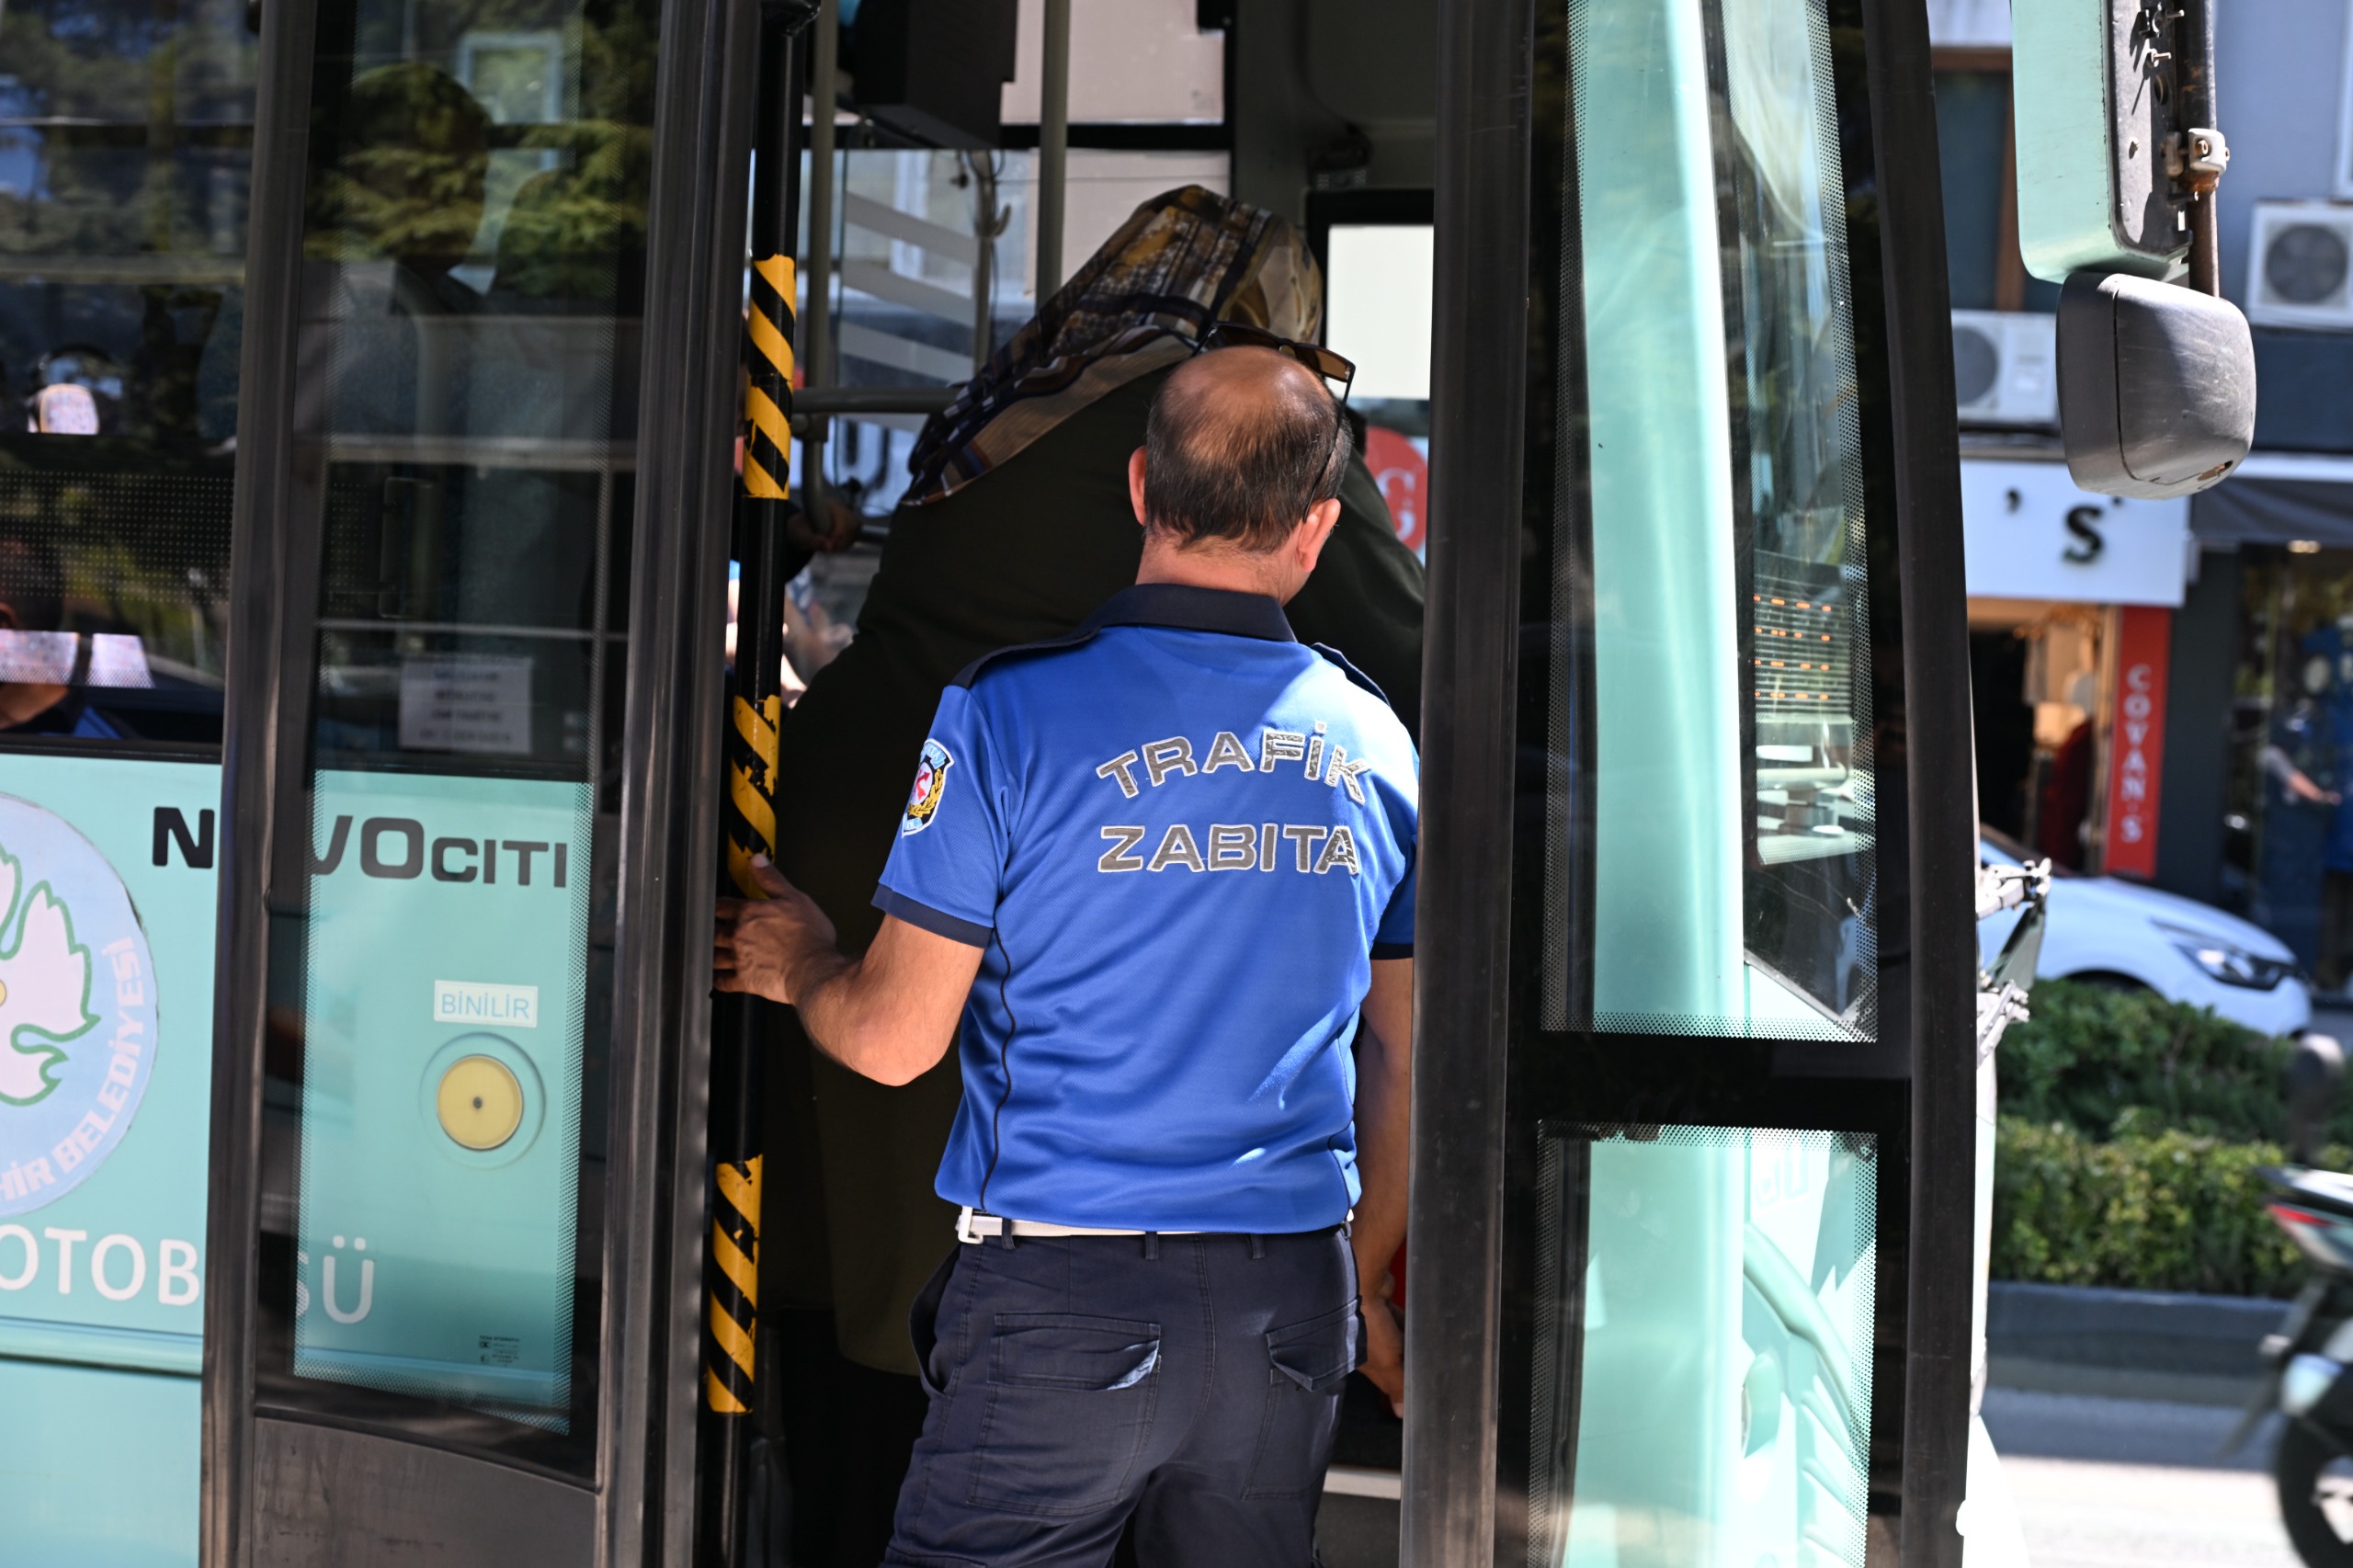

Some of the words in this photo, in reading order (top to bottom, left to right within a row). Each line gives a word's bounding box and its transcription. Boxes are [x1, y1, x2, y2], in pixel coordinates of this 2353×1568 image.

[1096, 721, 1371, 806] TRAFİK
[1097, 824, 1359, 875] ZABITA
[441, 991, 530, 1020] BİNİLİR
[51, 937, 144, 1174] BELEDİYESİ
